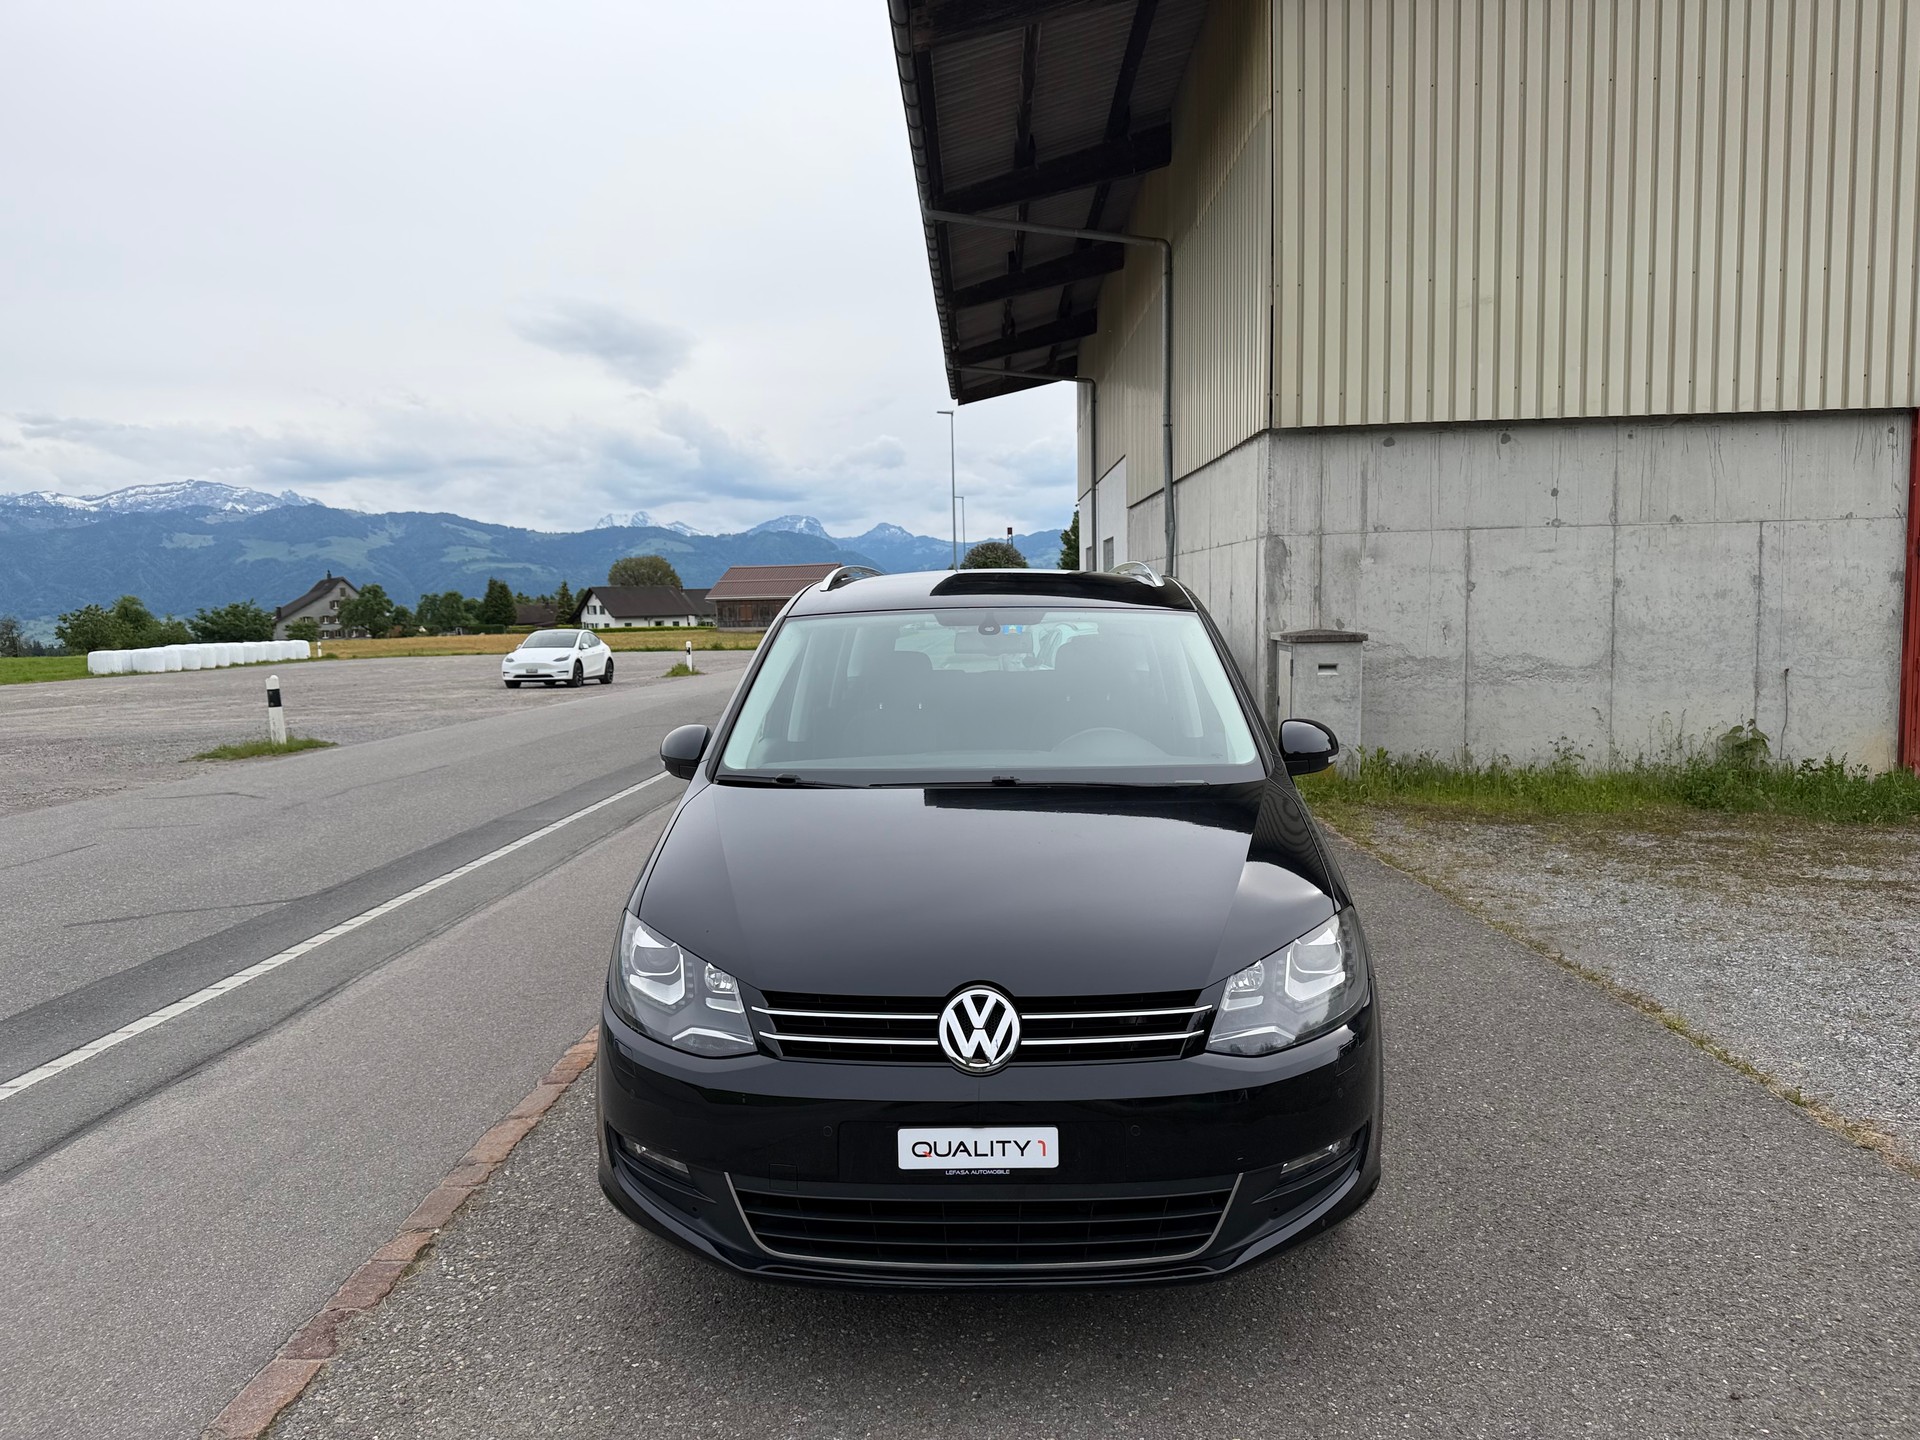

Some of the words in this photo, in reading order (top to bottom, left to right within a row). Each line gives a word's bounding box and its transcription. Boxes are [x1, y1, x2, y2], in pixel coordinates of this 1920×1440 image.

[941, 989, 1018, 1067] VW
[911, 1140, 1032, 1158] QUALITY
[1037, 1139, 1047, 1157] 1
